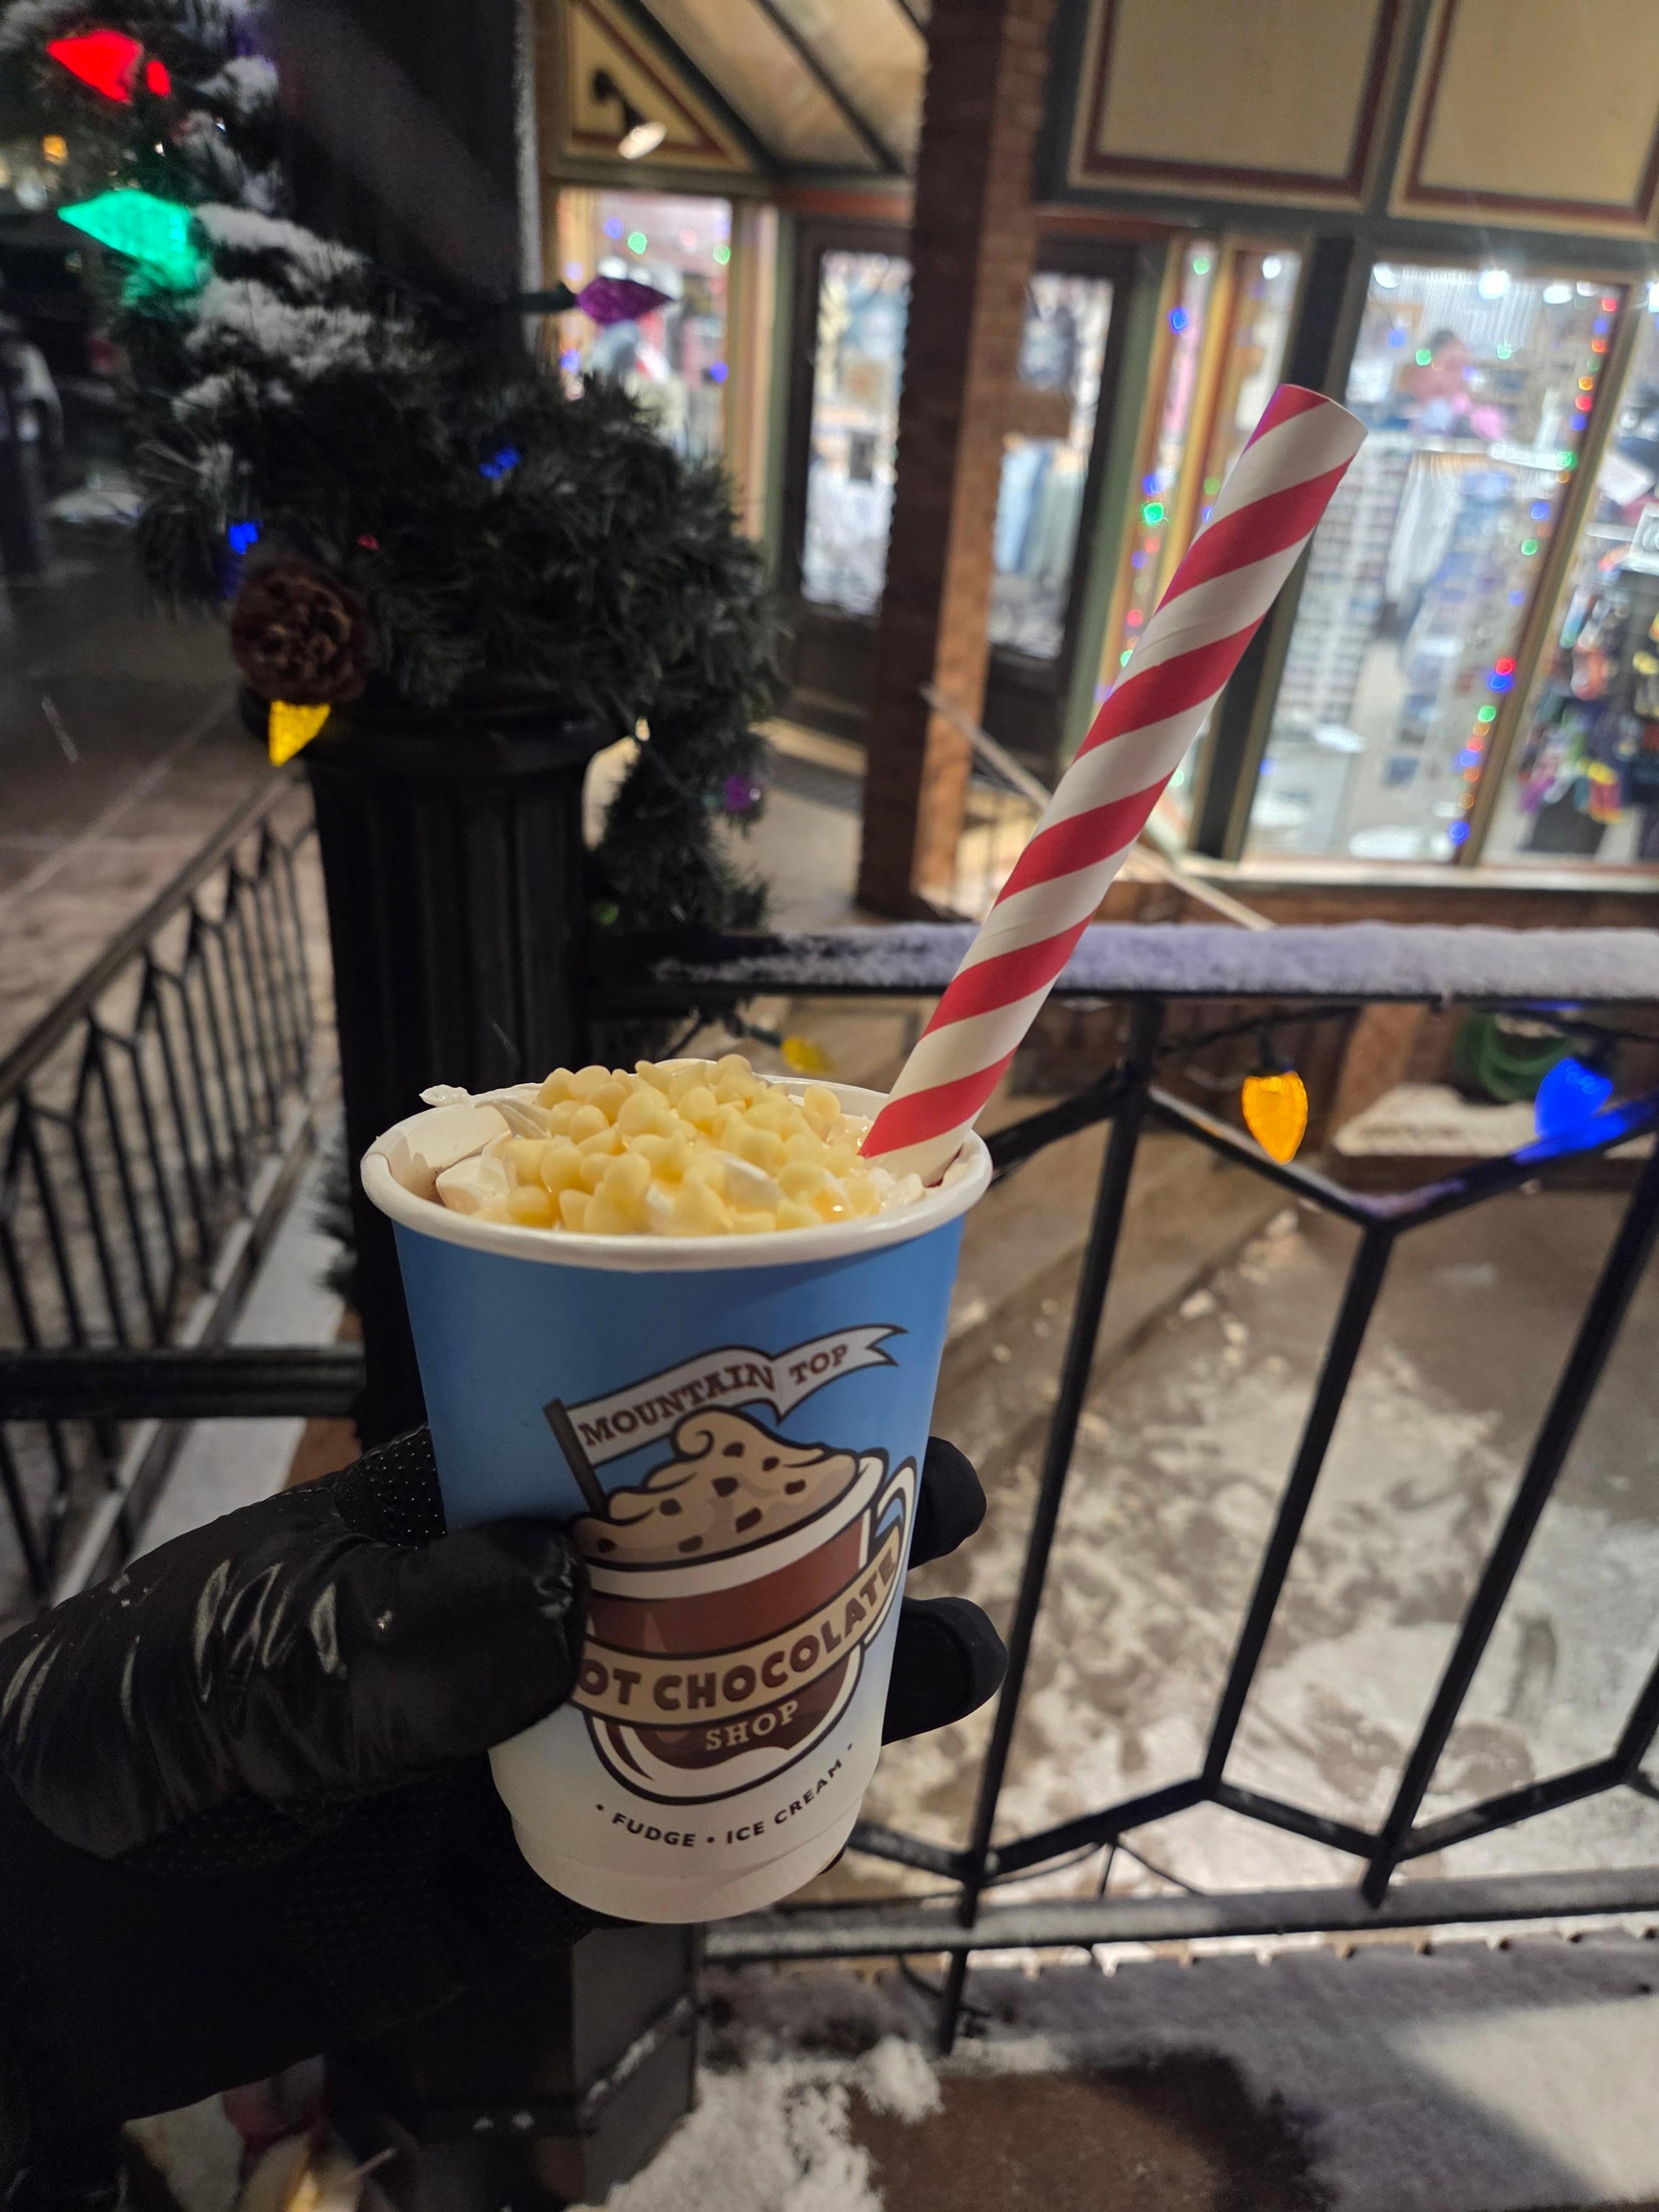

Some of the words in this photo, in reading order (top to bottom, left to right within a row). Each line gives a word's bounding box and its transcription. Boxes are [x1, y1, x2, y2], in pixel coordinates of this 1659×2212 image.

[579, 1361, 776, 1447] MOUNTAIN
[789, 1344, 848, 1383] TOP
[578, 1659, 641, 1705] OT
[653, 1546, 896, 1710] CHOCOLATE
[705, 1700, 799, 1751] SHOP
[612, 1812, 697, 1848] FUDGE
[726, 1821, 765, 1845] ICE
[774, 1759, 842, 1826] CREAM
